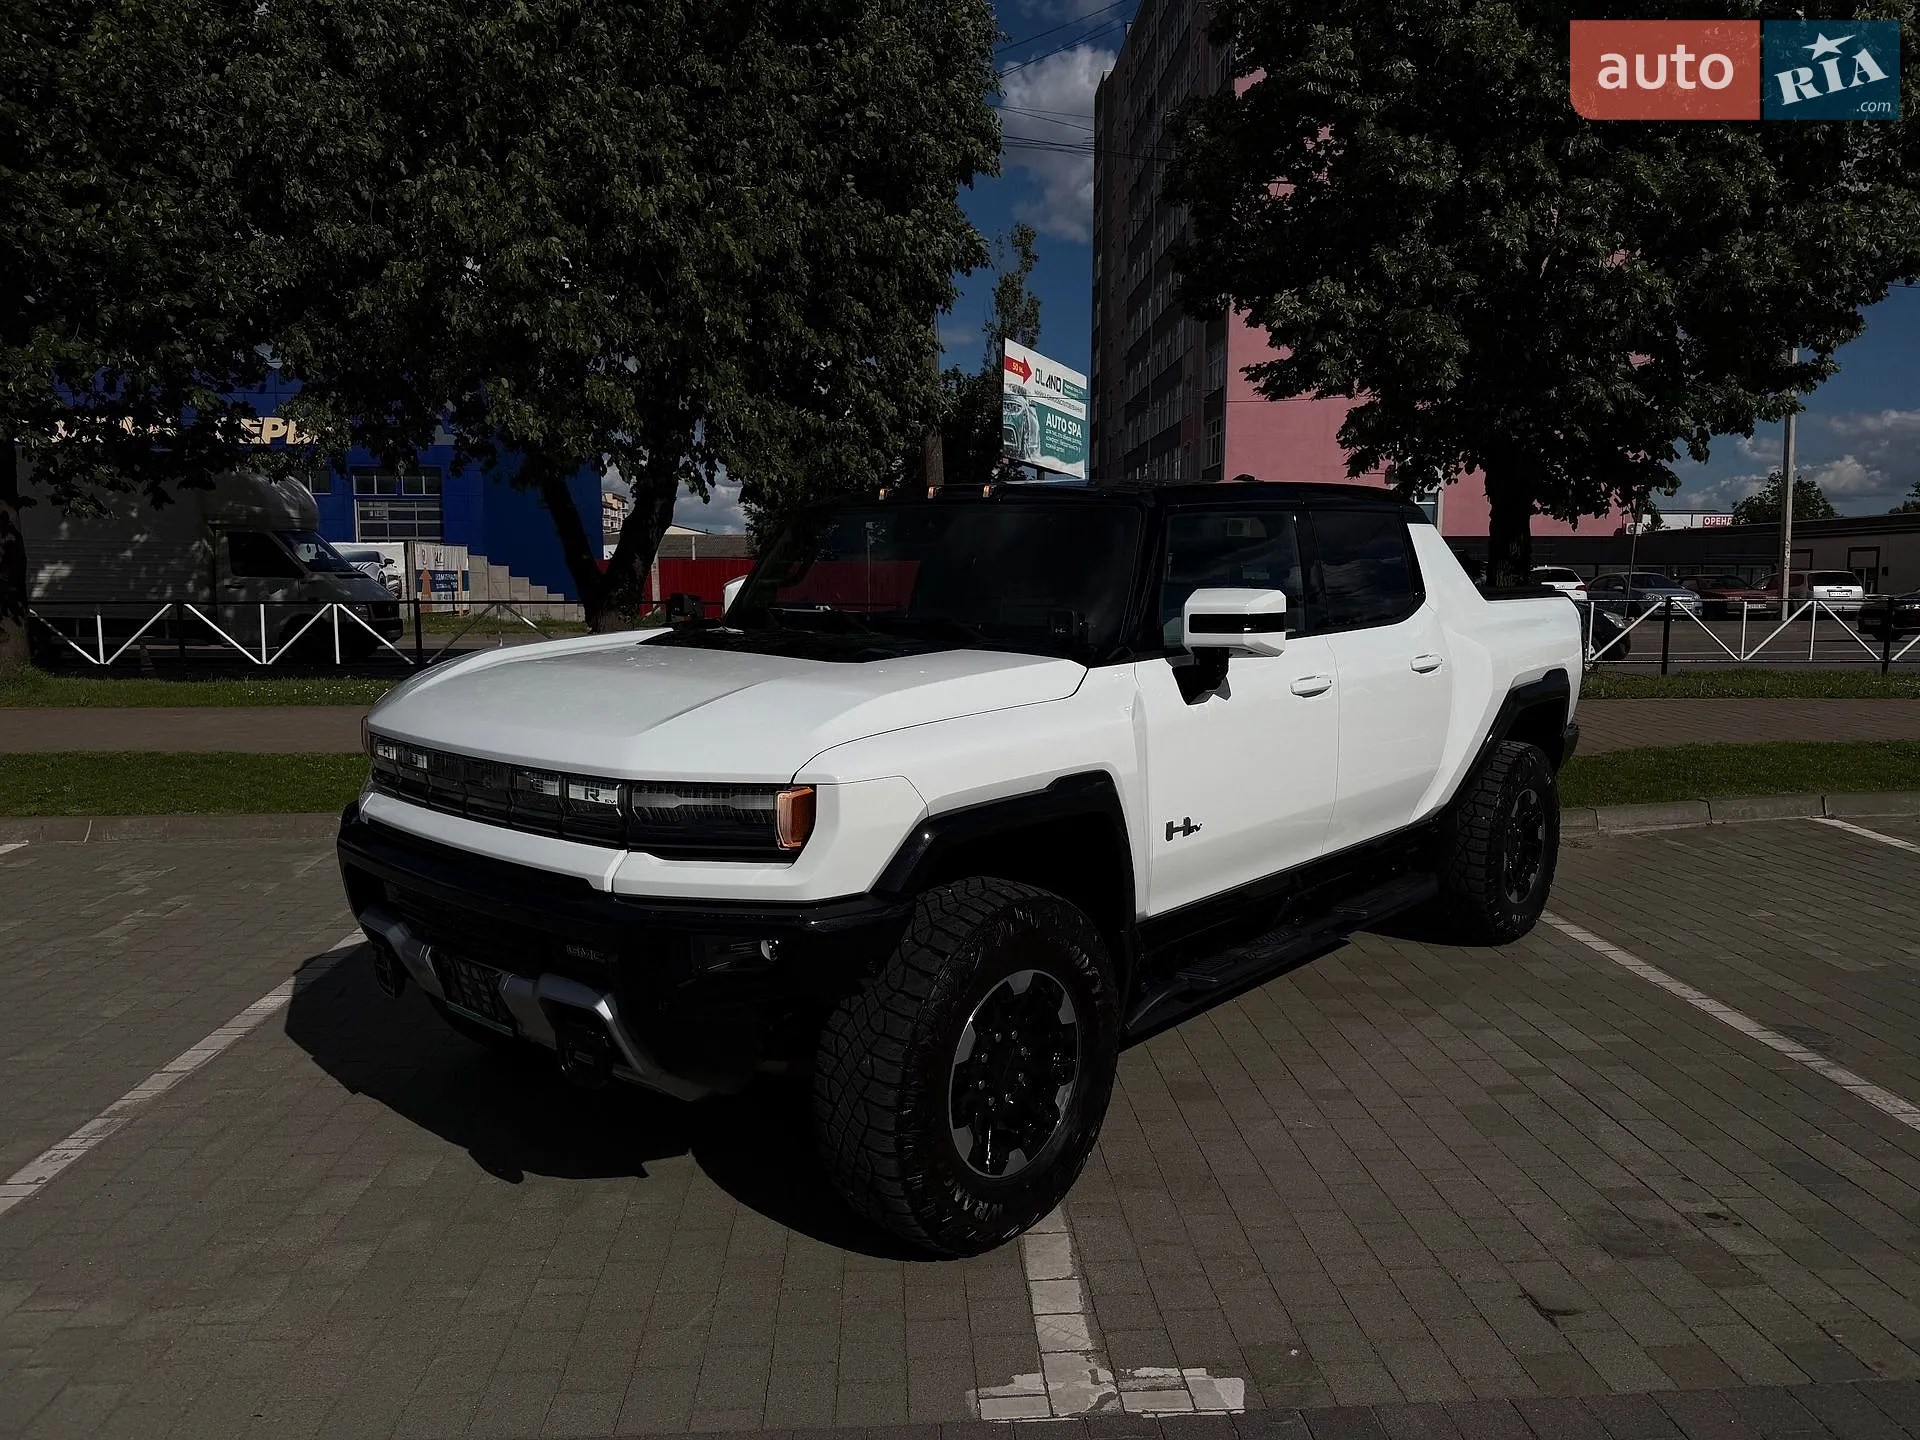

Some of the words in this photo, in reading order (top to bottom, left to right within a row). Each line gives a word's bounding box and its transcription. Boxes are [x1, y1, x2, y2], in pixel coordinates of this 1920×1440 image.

[1045, 412, 1067, 433] AUTO
[1067, 420, 1082, 439] SPA
[1704, 516, 1733, 526] ОРЕНД
